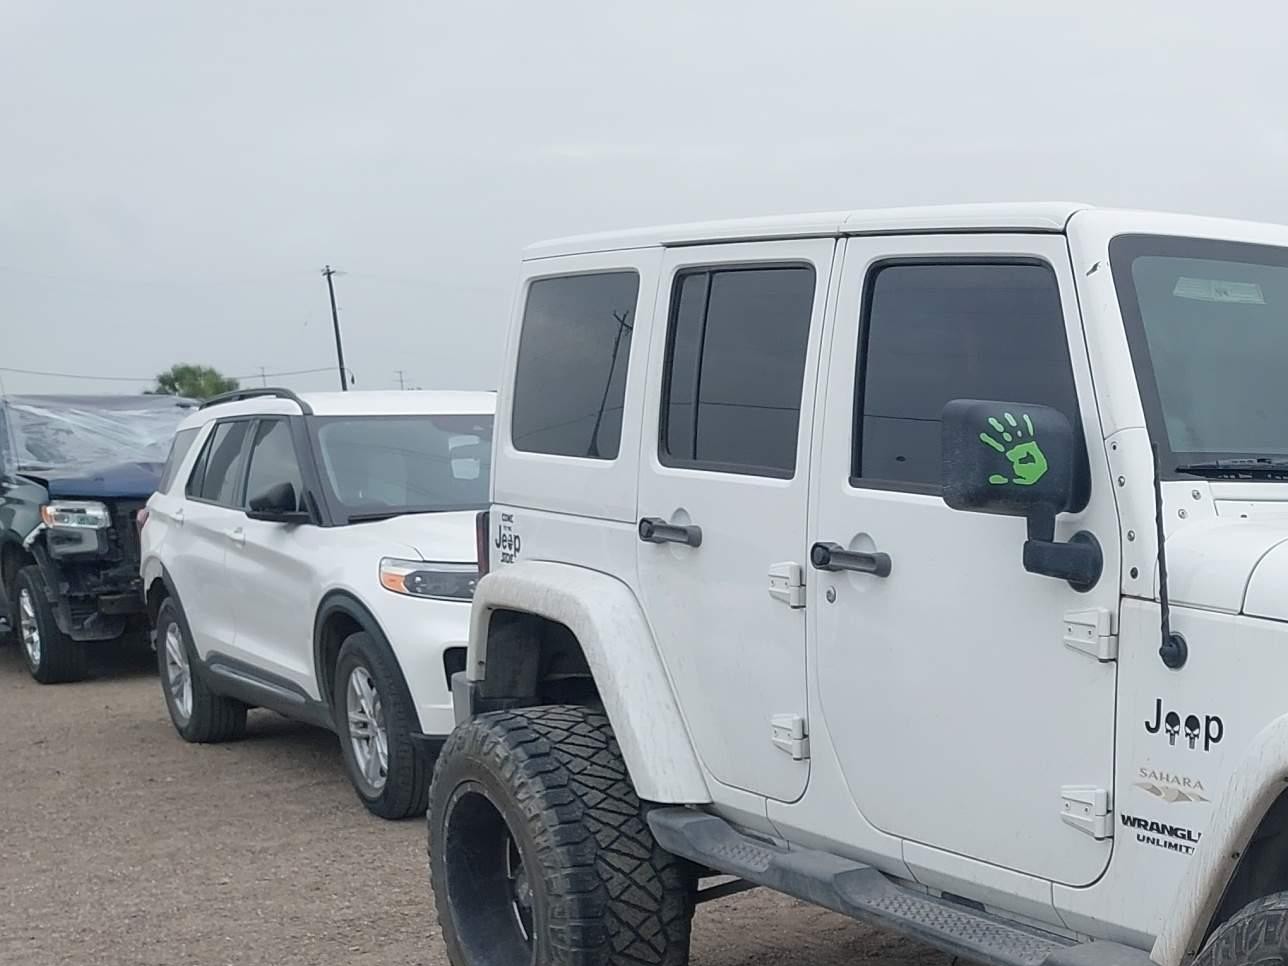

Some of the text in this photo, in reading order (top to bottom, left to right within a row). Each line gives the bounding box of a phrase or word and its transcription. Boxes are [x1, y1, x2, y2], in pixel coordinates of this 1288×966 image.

[1144, 698, 1224, 751] Jp
[1138, 767, 1205, 791] SAHARA
[1120, 813, 1202, 844] WRANGL
[1136, 833, 1195, 856] UNLIMIT
